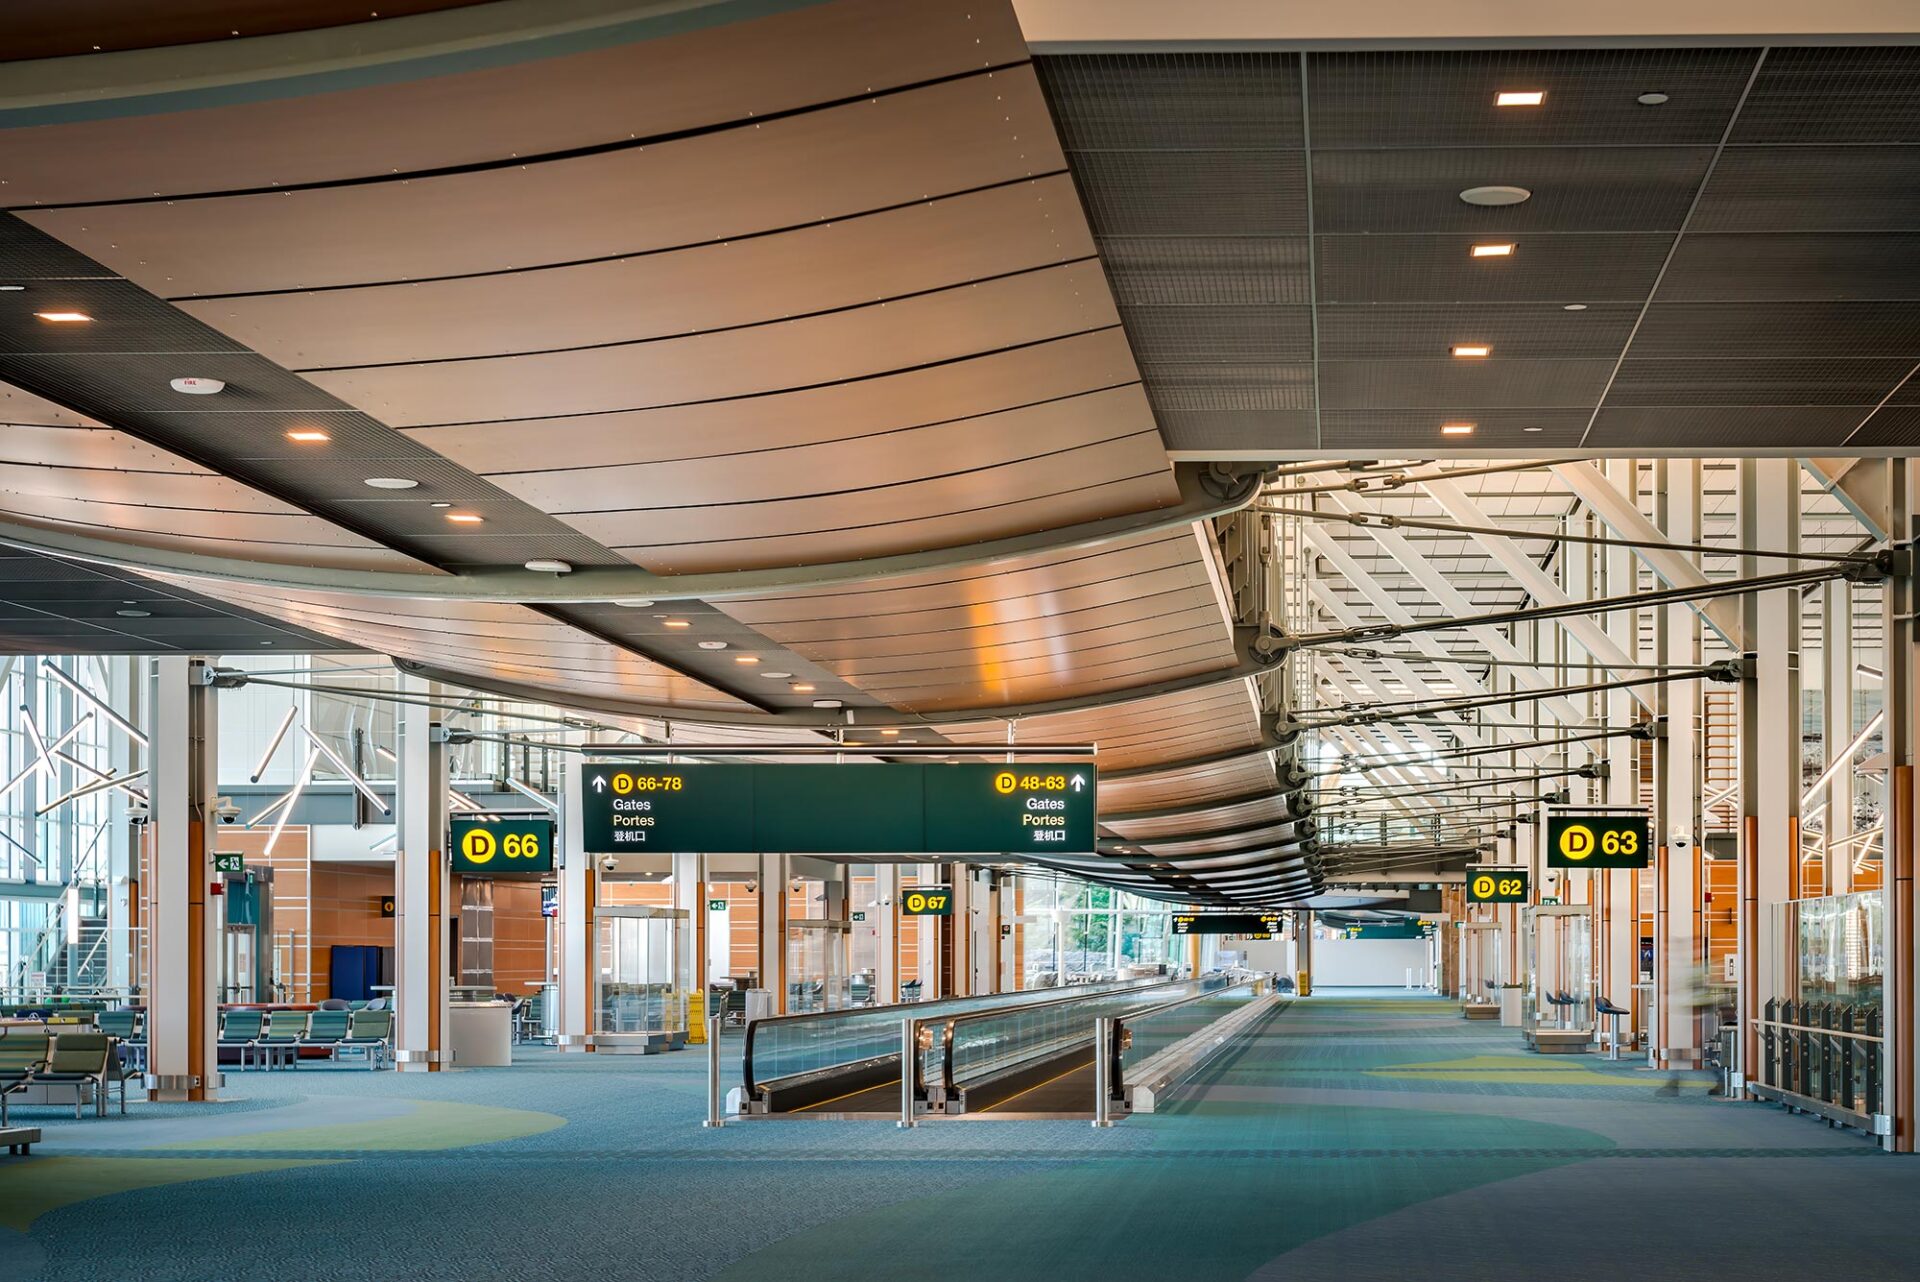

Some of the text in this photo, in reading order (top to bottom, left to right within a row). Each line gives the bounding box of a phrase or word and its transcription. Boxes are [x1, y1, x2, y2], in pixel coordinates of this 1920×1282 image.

[637, 777, 682, 791] 66-78
[1020, 776, 1066, 790] 48-63
[613, 799, 651, 811] Gates
[1026, 798, 1066, 810] Gates
[613, 815, 655, 826] Portes
[1022, 814, 1066, 826] Portes
[614, 831, 646, 842] 登机口
[1033, 830, 1066, 842] 登机口
[1602, 830, 1638, 855] 63
[503, 833, 539, 858] 66
[1499, 879, 1522, 895] 62
[927, 896, 947, 910] 67
